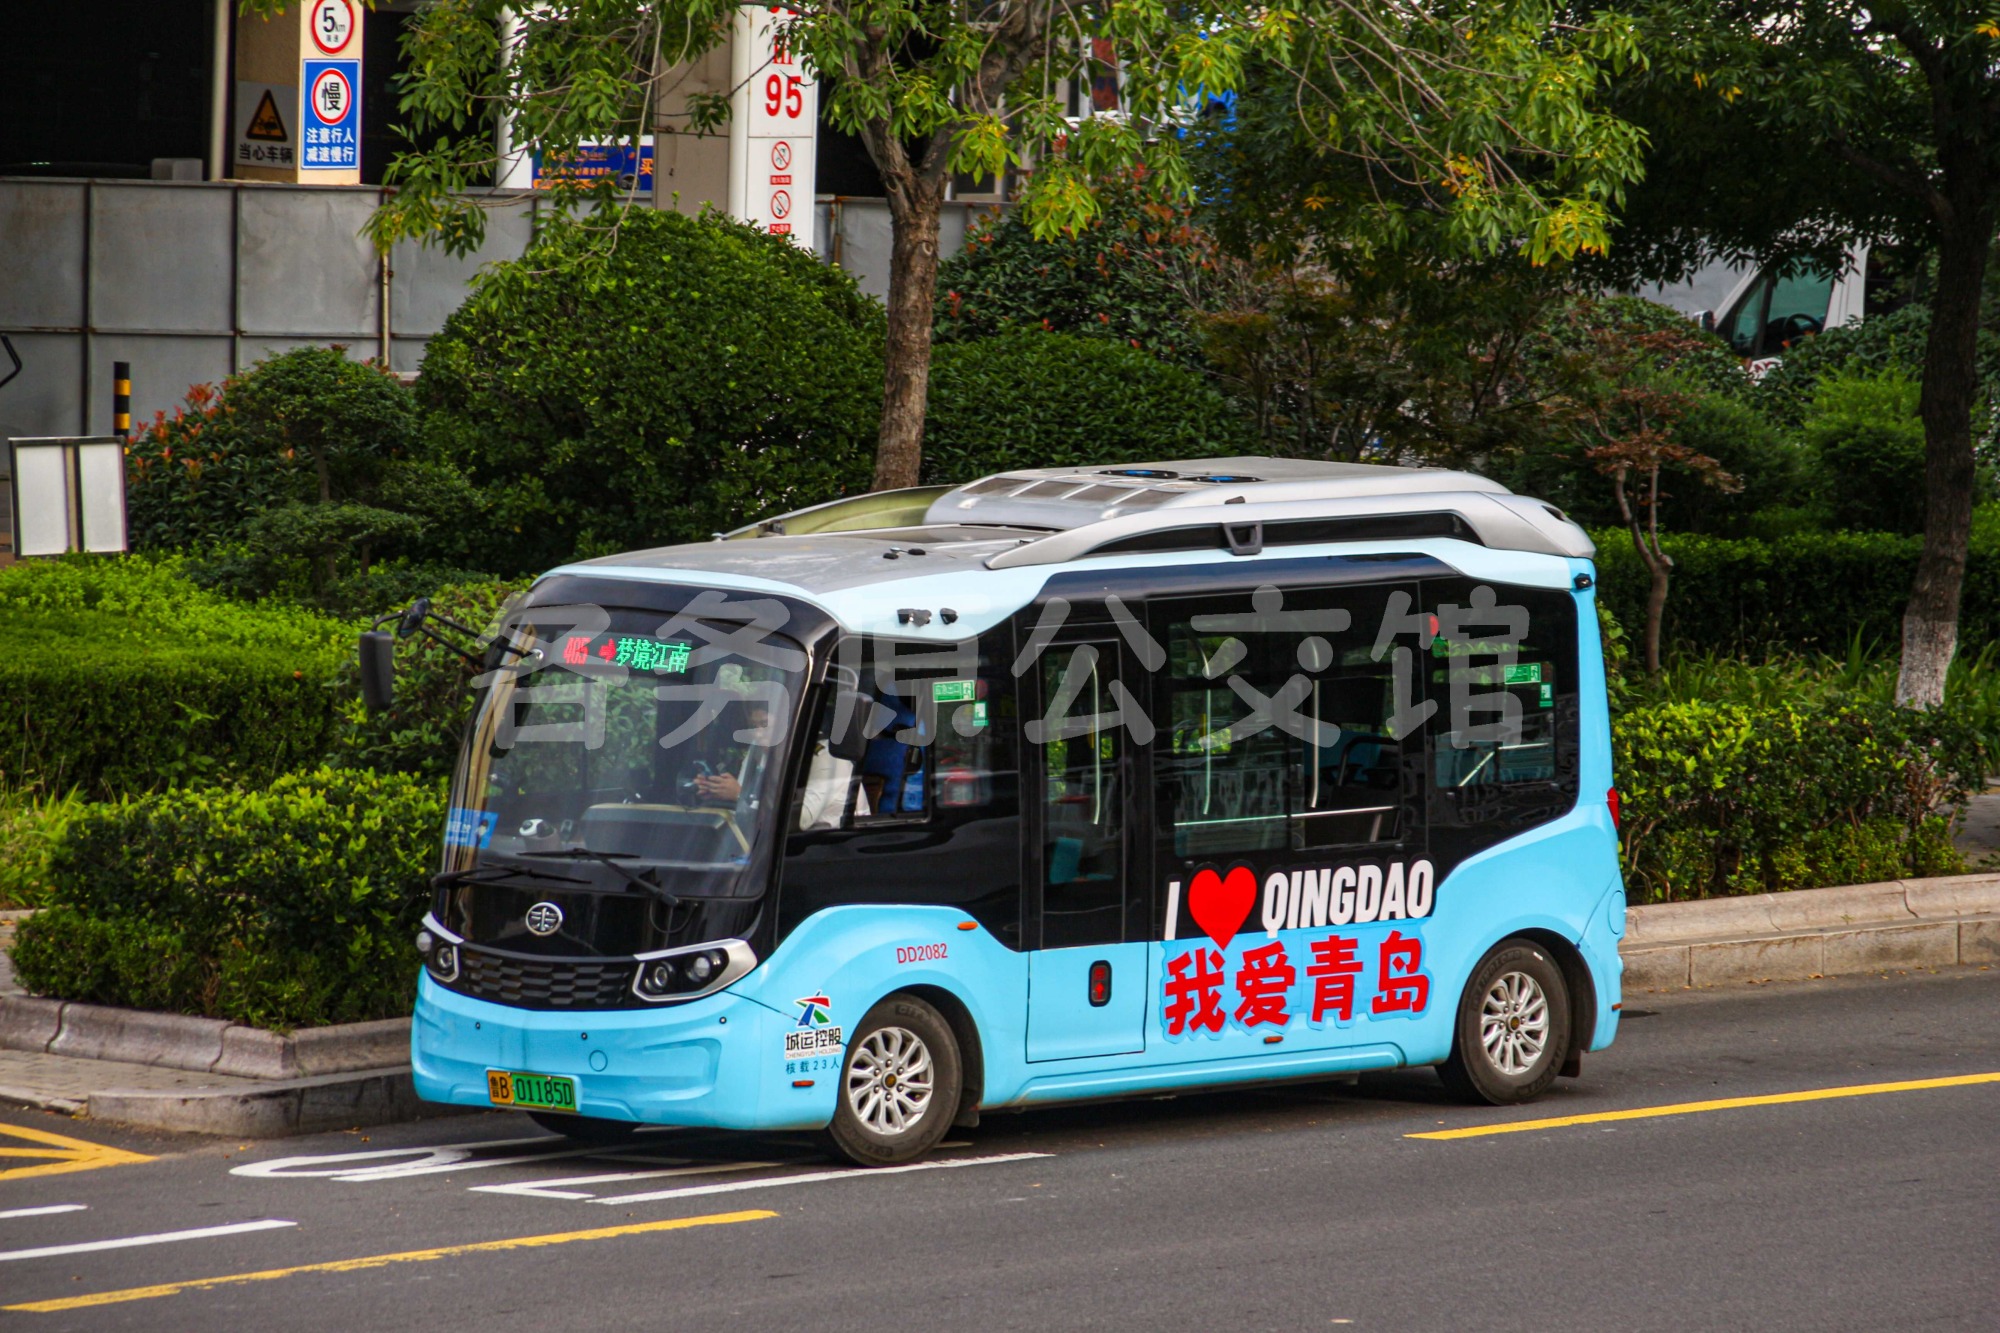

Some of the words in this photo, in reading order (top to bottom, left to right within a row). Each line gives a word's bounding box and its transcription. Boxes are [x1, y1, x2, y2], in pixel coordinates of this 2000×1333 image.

[321, 81, 341, 111] 慢
[765, 73, 803, 119] 95
[306, 127, 354, 144] 注意行人
[239, 143, 293, 164] 当心车辆
[306, 146, 354, 162] 减速慢行
[1164, 880, 1181, 941] I
[1262, 859, 1434, 938] QINGDAO
[896, 943, 948, 964] DD2082
[1164, 930, 1430, 1037] 我爱青岛
[785, 1027, 841, 1051] 城运控股
[786, 1051, 815, 1059] CHENGYUN
[818, 1047, 841, 1055] HOLDING
